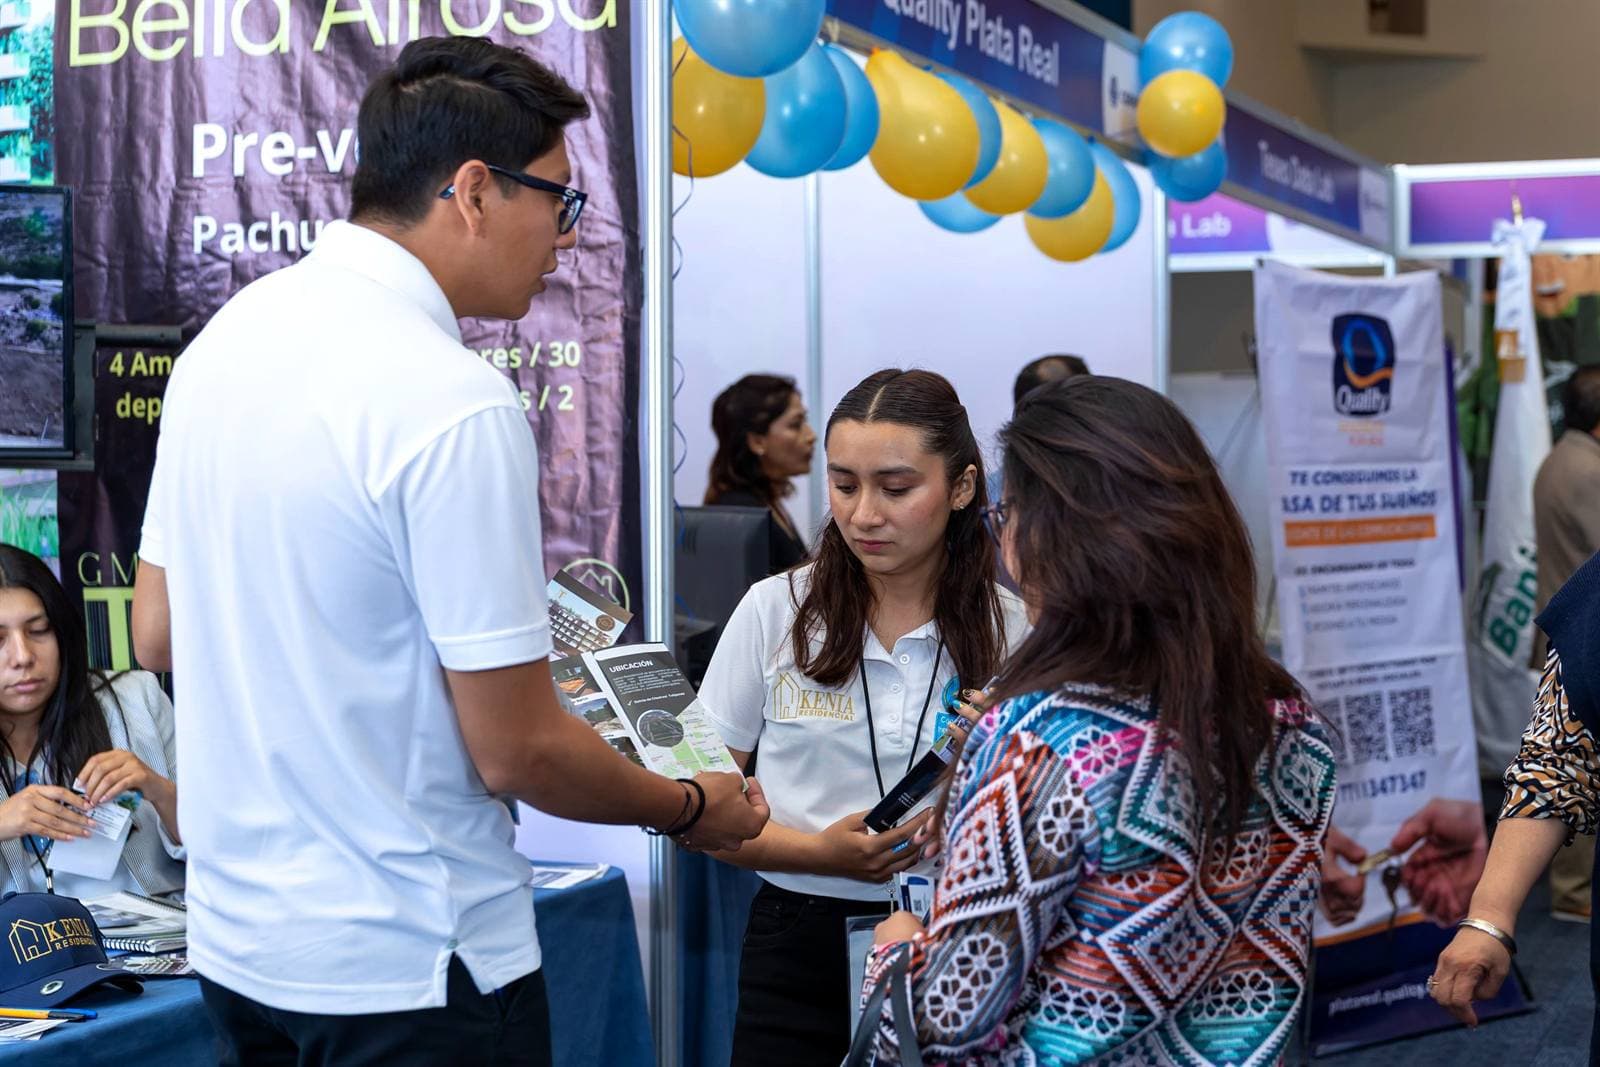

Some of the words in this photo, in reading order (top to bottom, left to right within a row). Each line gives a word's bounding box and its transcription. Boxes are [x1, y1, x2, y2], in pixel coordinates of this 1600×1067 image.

[69, 0, 291, 67] Bella
[966, 0, 1014, 66] Plata
[1018, 25, 1059, 86] Real
[192, 122, 360, 178] Pre-v
[1182, 211, 1232, 239] Lab
[109, 351, 125, 377] 4
[470, 346, 522, 368] res
[529, 341, 541, 368] /
[548, 341, 581, 367] 30
[538, 384, 551, 411] /
[557, 384, 575, 410] 2
[1289, 470, 1307, 486] TE
[1320, 493, 1343, 513] DE
[1347, 492, 1376, 511] TUS
[1489, 546, 1537, 657] Ban
[609, 659, 654, 673] UBICACIÓN
[800, 689, 855, 715] KENIA
